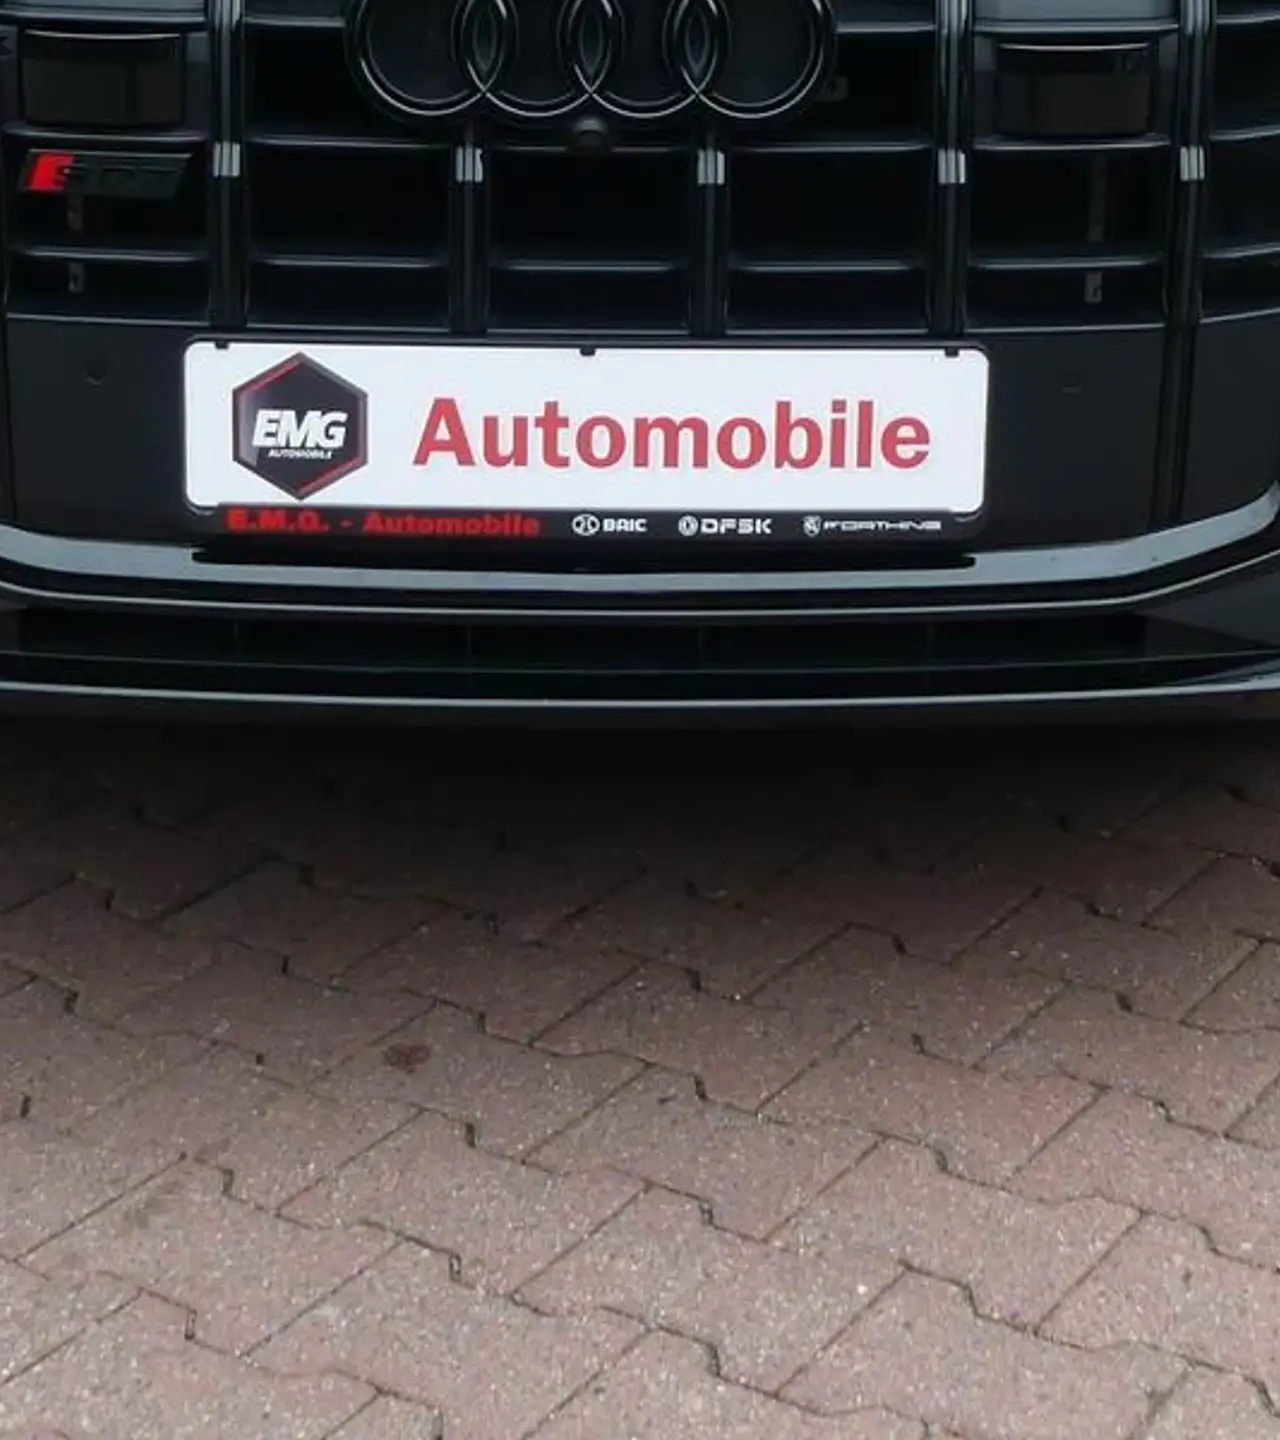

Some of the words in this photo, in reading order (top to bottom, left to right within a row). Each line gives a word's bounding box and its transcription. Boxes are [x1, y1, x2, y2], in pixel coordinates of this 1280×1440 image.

[252, 408, 348, 449] EMG
[413, 397, 930, 470] Automobile
[361, 511, 541, 538] Automobile
[602, 518, 647, 533] BAIC
[700, 518, 772, 535] DFSK
